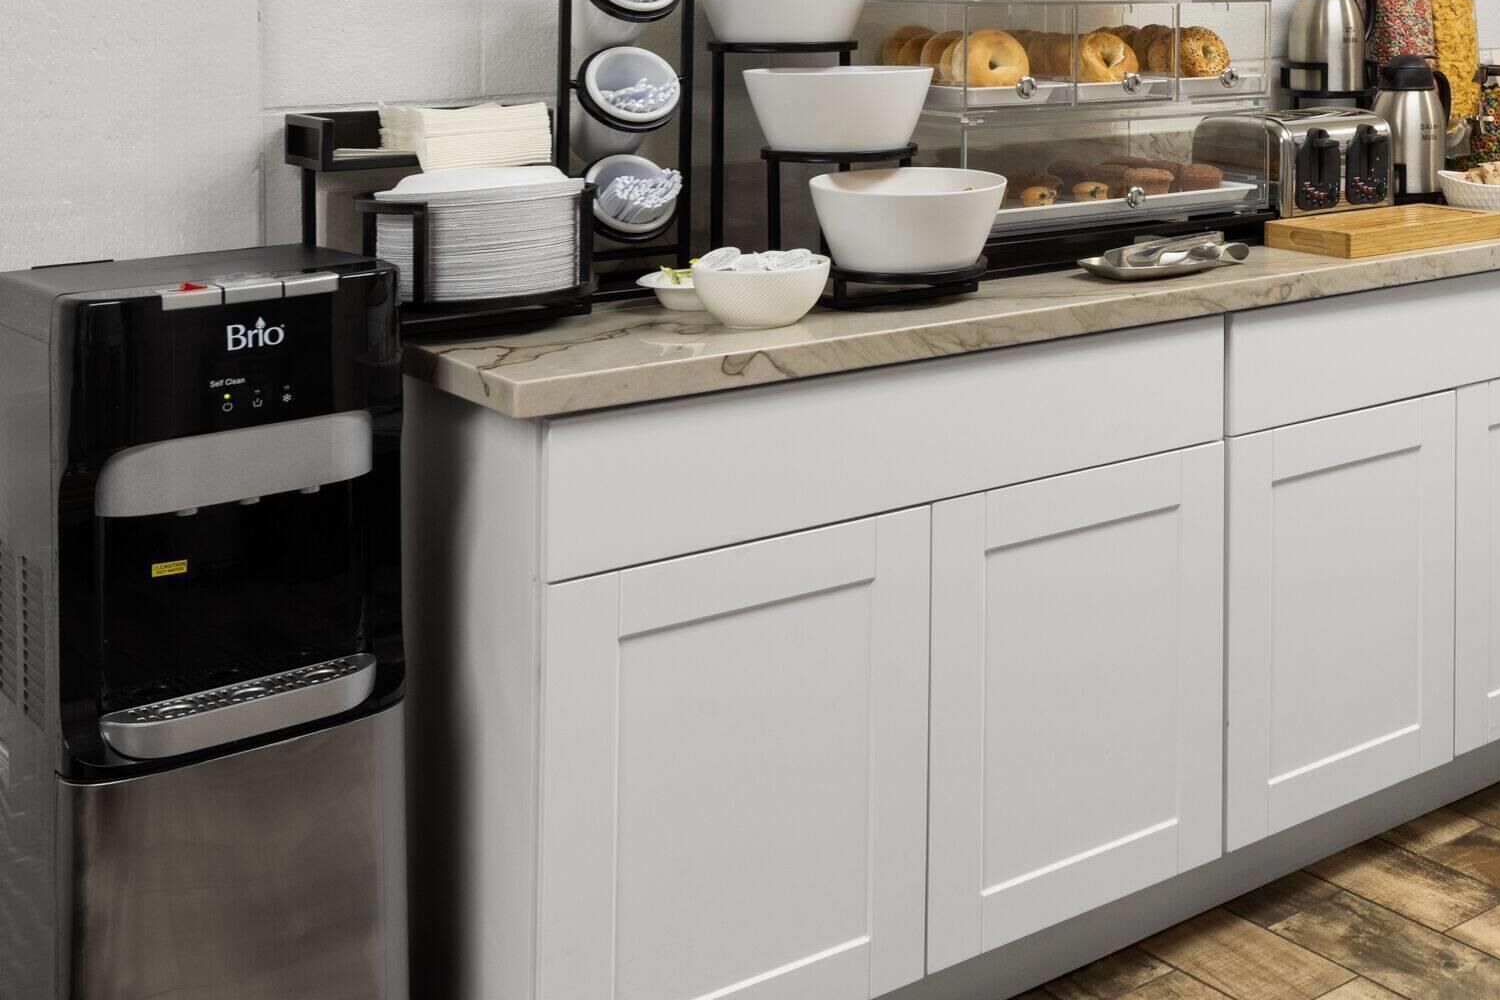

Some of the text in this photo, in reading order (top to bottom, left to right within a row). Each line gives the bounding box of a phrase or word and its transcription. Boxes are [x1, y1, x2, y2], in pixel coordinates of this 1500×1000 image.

[226, 316, 285, 351] Brio
[209, 377, 246, 388] Self Clean
